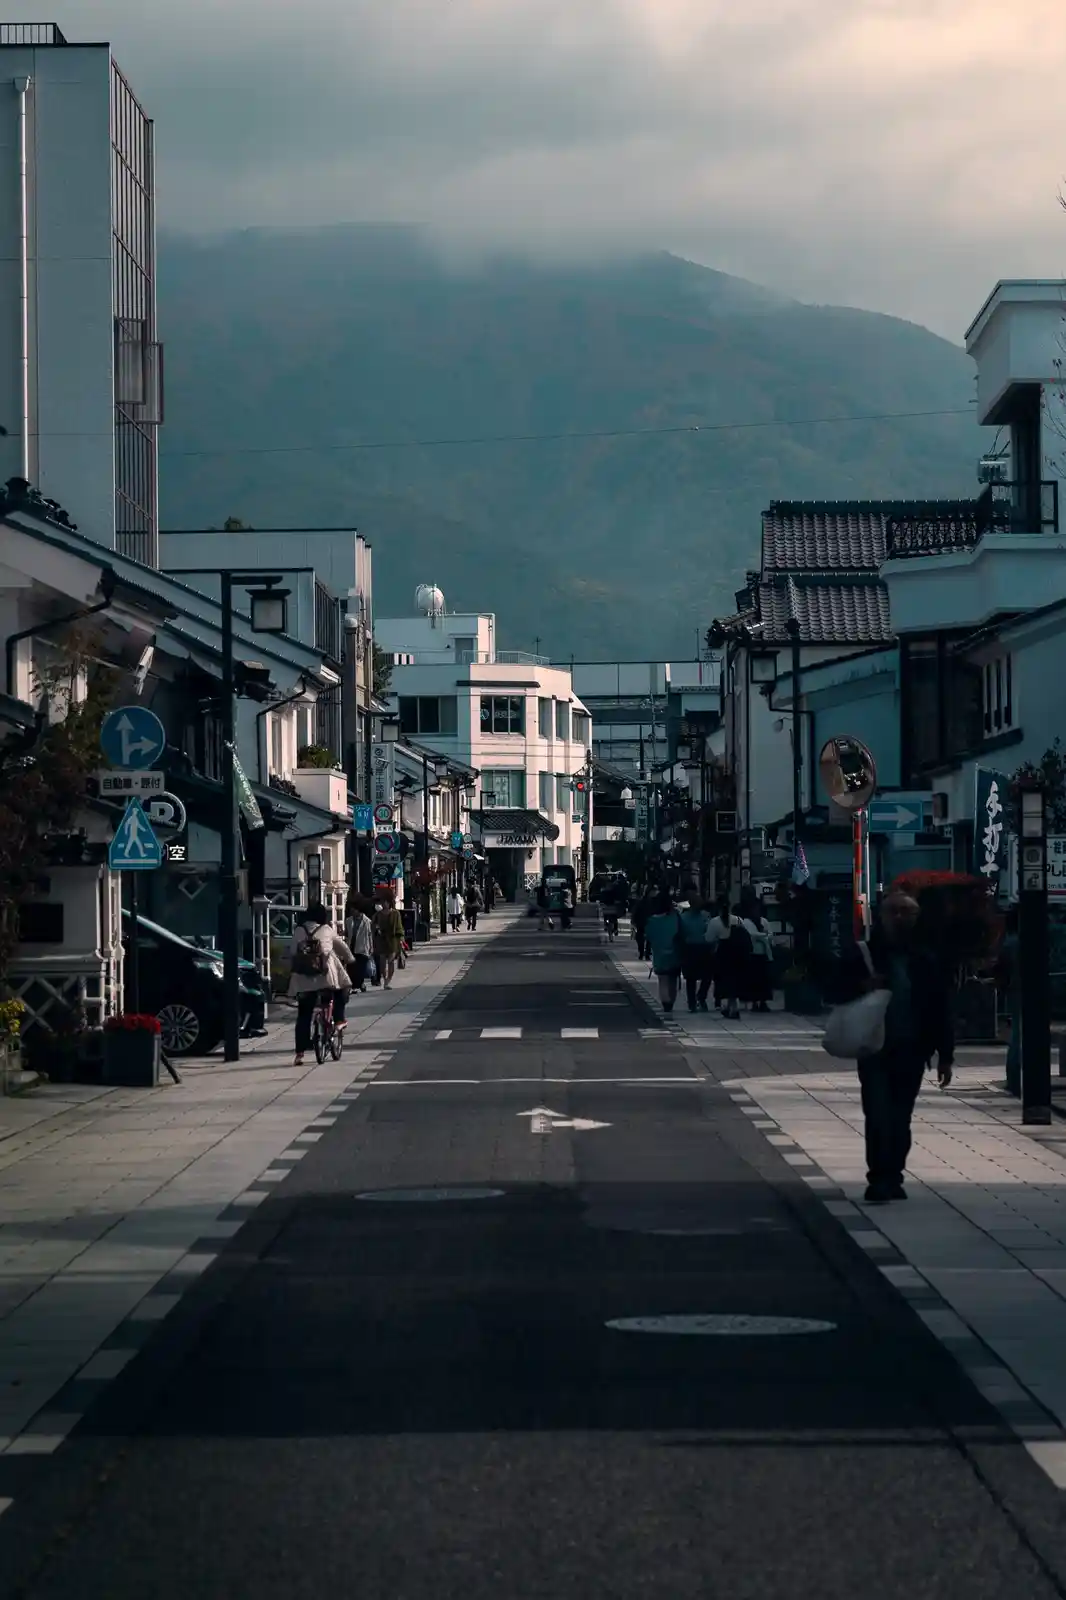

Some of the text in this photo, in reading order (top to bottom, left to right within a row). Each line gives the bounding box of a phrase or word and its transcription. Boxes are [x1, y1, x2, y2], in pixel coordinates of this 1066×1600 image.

[103, 777, 161, 790] 自動車・原付
[500, 834, 539, 845] HAYAMA
[169, 845, 186, 861] 空
